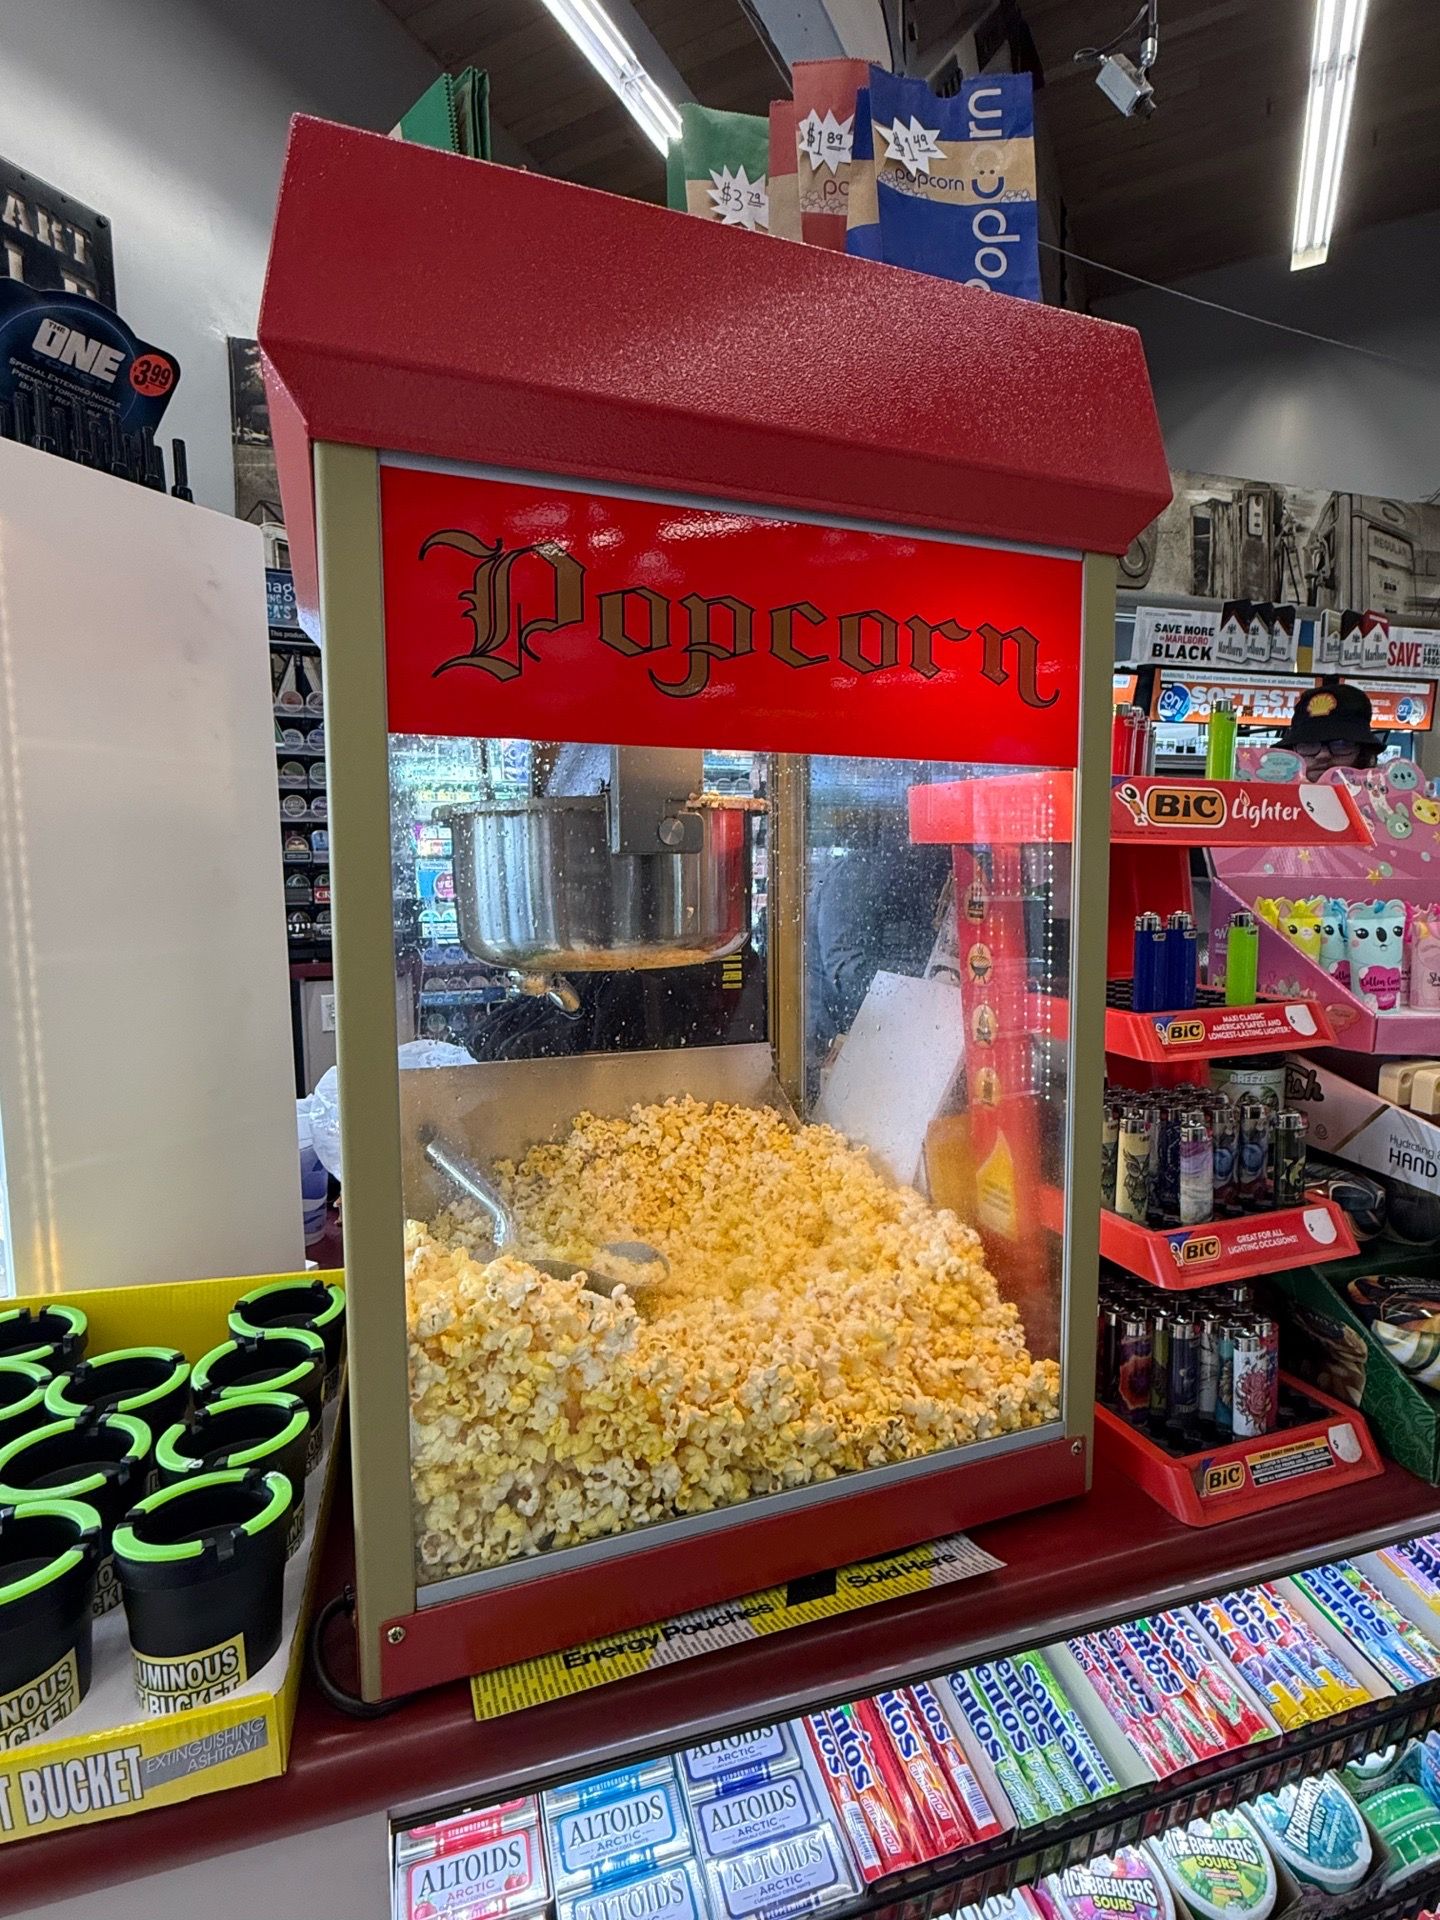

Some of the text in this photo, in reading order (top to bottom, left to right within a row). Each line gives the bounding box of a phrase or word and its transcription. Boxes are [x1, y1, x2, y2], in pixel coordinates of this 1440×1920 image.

[895, 167, 965, 191] popcorn
[32, 318, 127, 383] ONE
[9, 356, 46, 380] SPECIAL
[47, 373, 91, 396] EXTENDED
[91, 390, 121, 408] NOZZLE
[417, 528, 1061, 709] Popcorn
[1154, 623, 1215, 636] SAVE MORE
[1152, 643, 1213, 661] BLACK
[1165, 635, 1209, 645] MARLBORO
[1218, 638, 1243, 657] Marlboro
[1387, 640, 1423, 667] SAVE
[1191, 686, 1300, 709] SOFTEST
[1232, 792, 1301, 828] Lighter
[1212, 1019, 1281, 1032] AMERICA'S SAFEST AND
[1222, 1012, 1265, 1023] MAXI CLASSIC
[1208, 1029, 1264, 1041] LONGEST-LASTING
[1230, 1073, 1268, 1084] BREEZE
[1390, 1134, 1434, 1160] Hydrating
[1389, 1148, 1437, 1178] HAND
[1228, 1235, 1298, 1255] LIGHTING OCCASIONS!
[1236, 1229, 1284, 1243] GREAT FOR ALL
[847, 1551, 958, 1590] Sold Here
[563, 1603, 774, 1669] Energy Pouches
[1021, 1661, 1105, 1798] mentos
[146, 1716, 266, 1774] EXTINGUISHING
[717, 1746, 756, 1764] ARCTIC
[19, 1745, 145, 1826] BUCKET
[570, 1794, 664, 1848] ALTOIDS
[711, 1785, 797, 1832] ALTOIDS
[738, 1817, 778, 1838] ARCTIC
[1310, 1805, 1327, 1839] MINTS
[597, 1830, 642, 1852] ARCTIC
[1190, 1835, 1258, 1866] BREAKERS
[419, 1840, 522, 1898] ALTOIDS
[731, 1835, 823, 1892] ALTOIDS
[1196, 1857, 1237, 1870] SOURS
[447, 1879, 496, 1901] ARCTIC
[760, 1873, 802, 1896] ARCTIC
[1090, 1875, 1158, 1908] BREAKERS
[1093, 1895, 1136, 1913] SOURS
